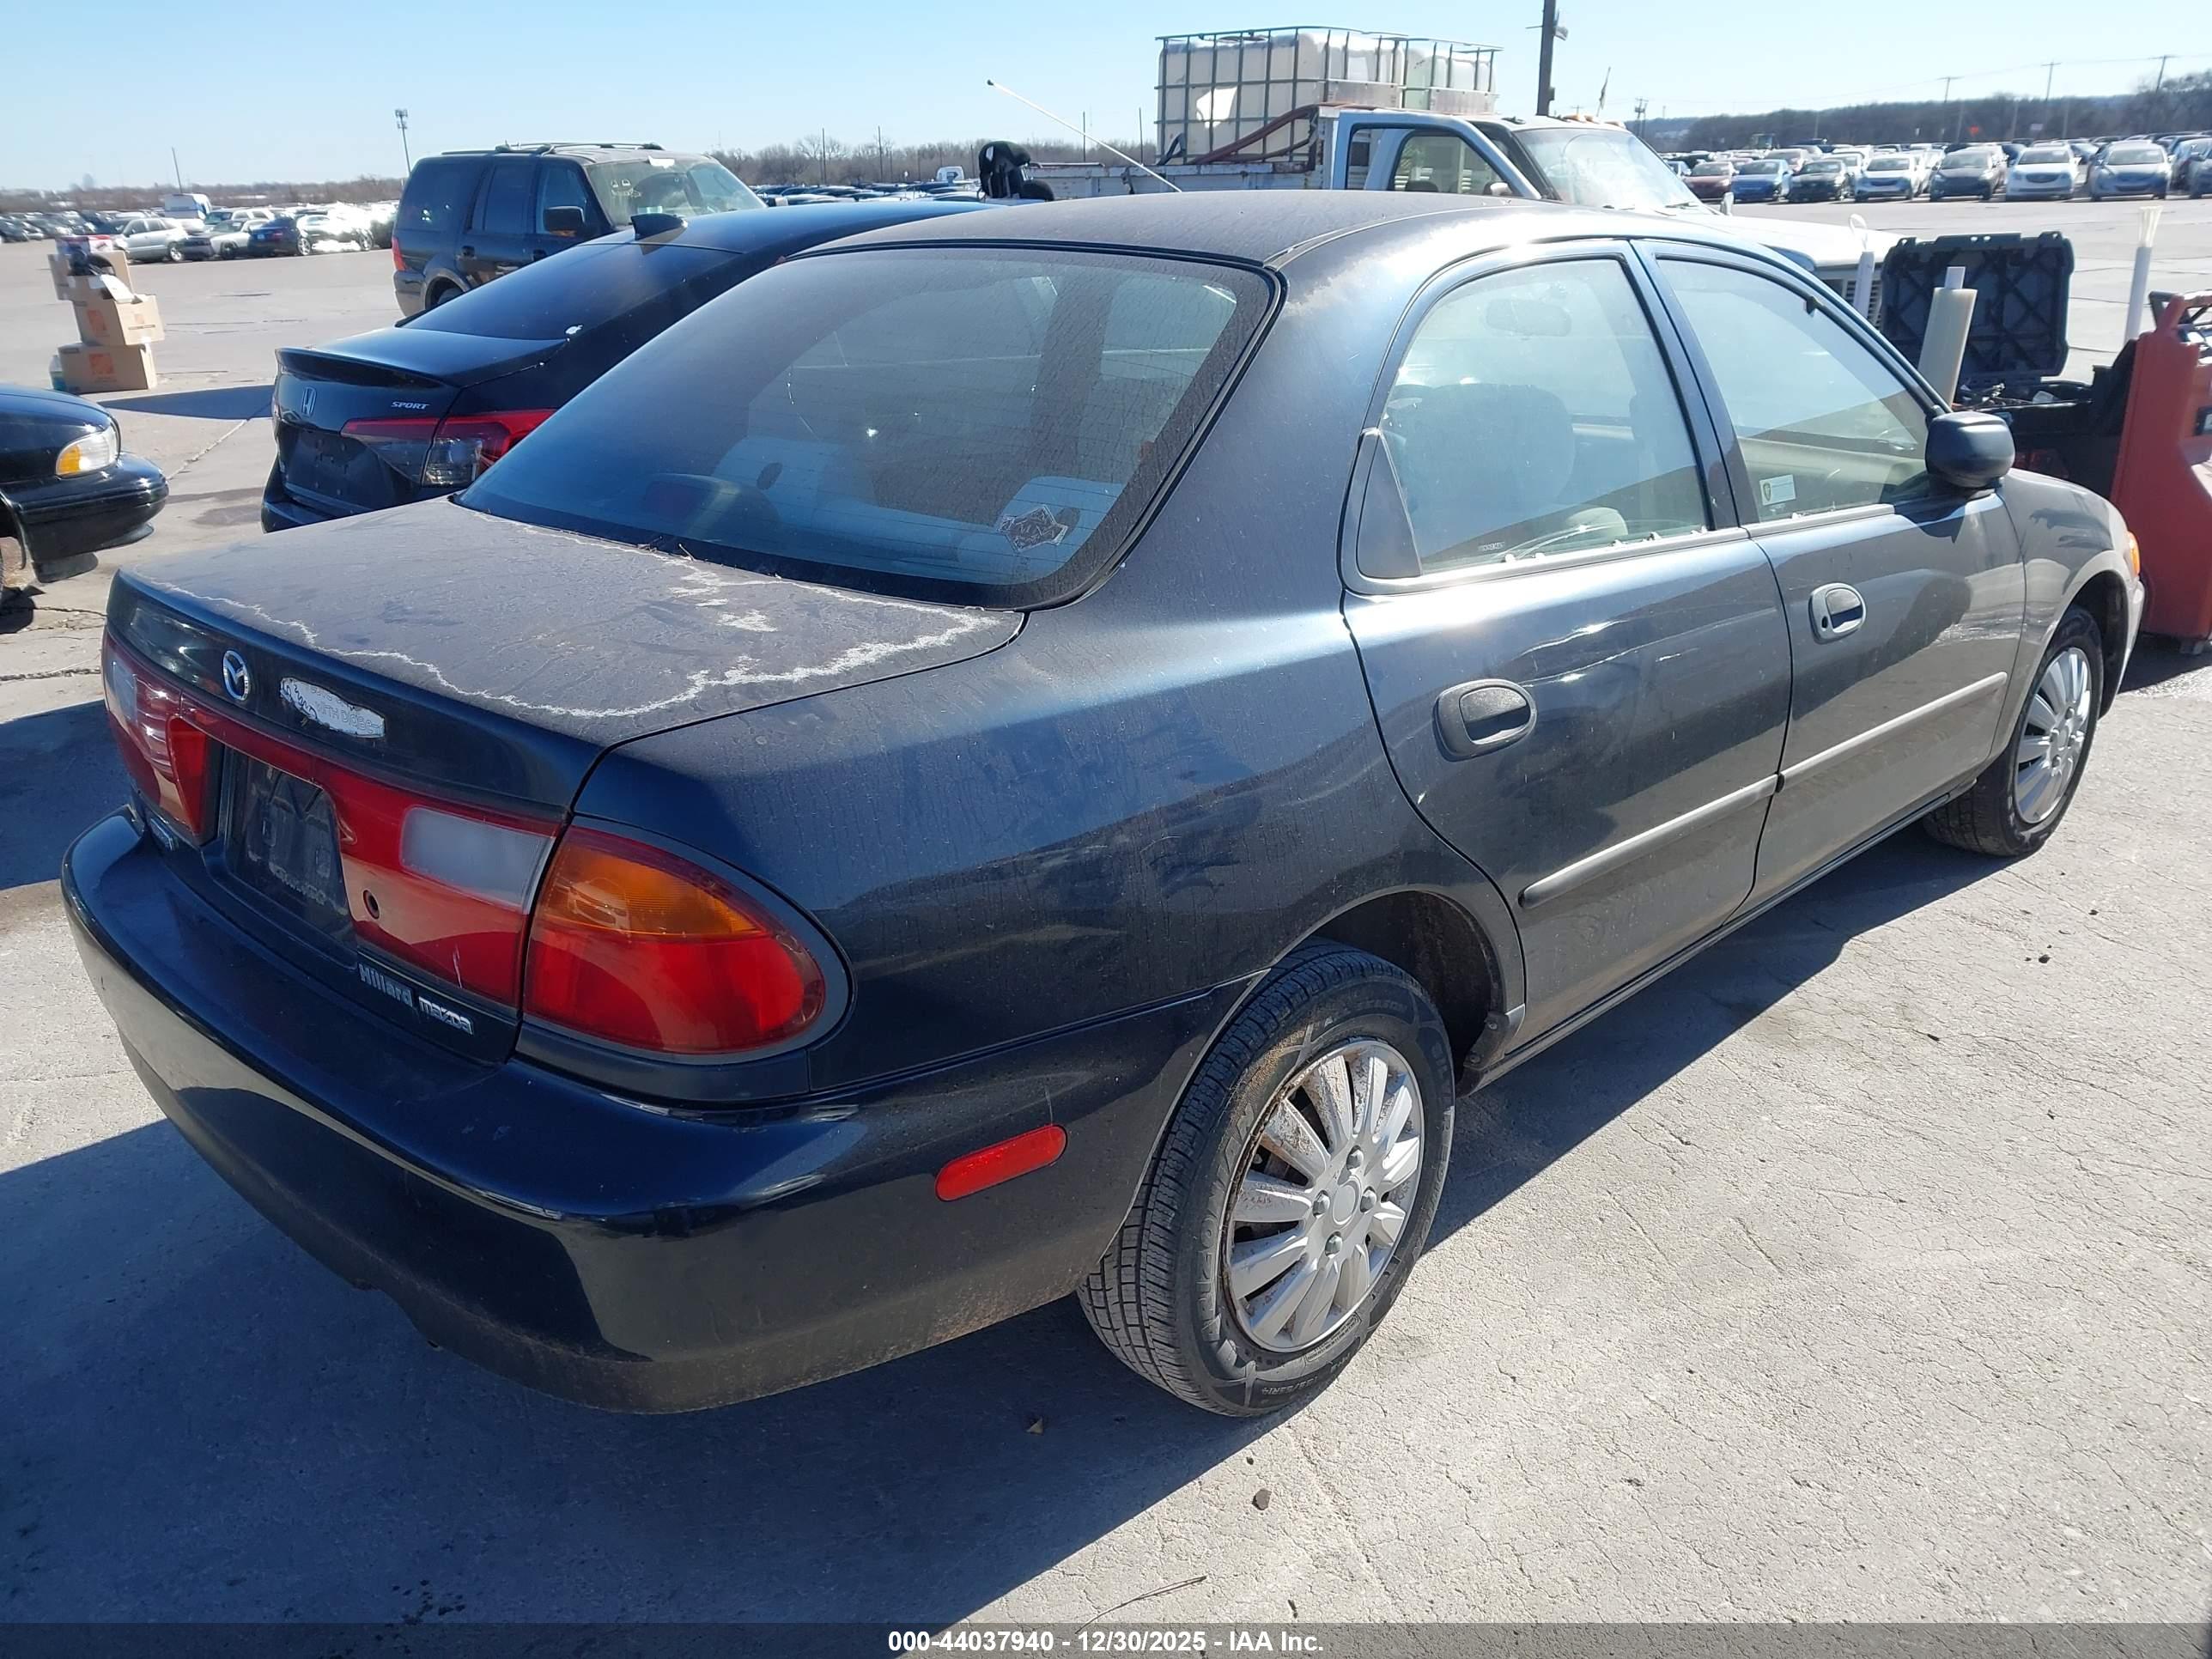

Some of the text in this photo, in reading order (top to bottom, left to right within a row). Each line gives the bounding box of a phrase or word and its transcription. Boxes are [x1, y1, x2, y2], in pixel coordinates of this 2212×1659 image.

[391, 401, 430, 410] SPORT
[358, 963, 473, 1036] Hillard mazda
